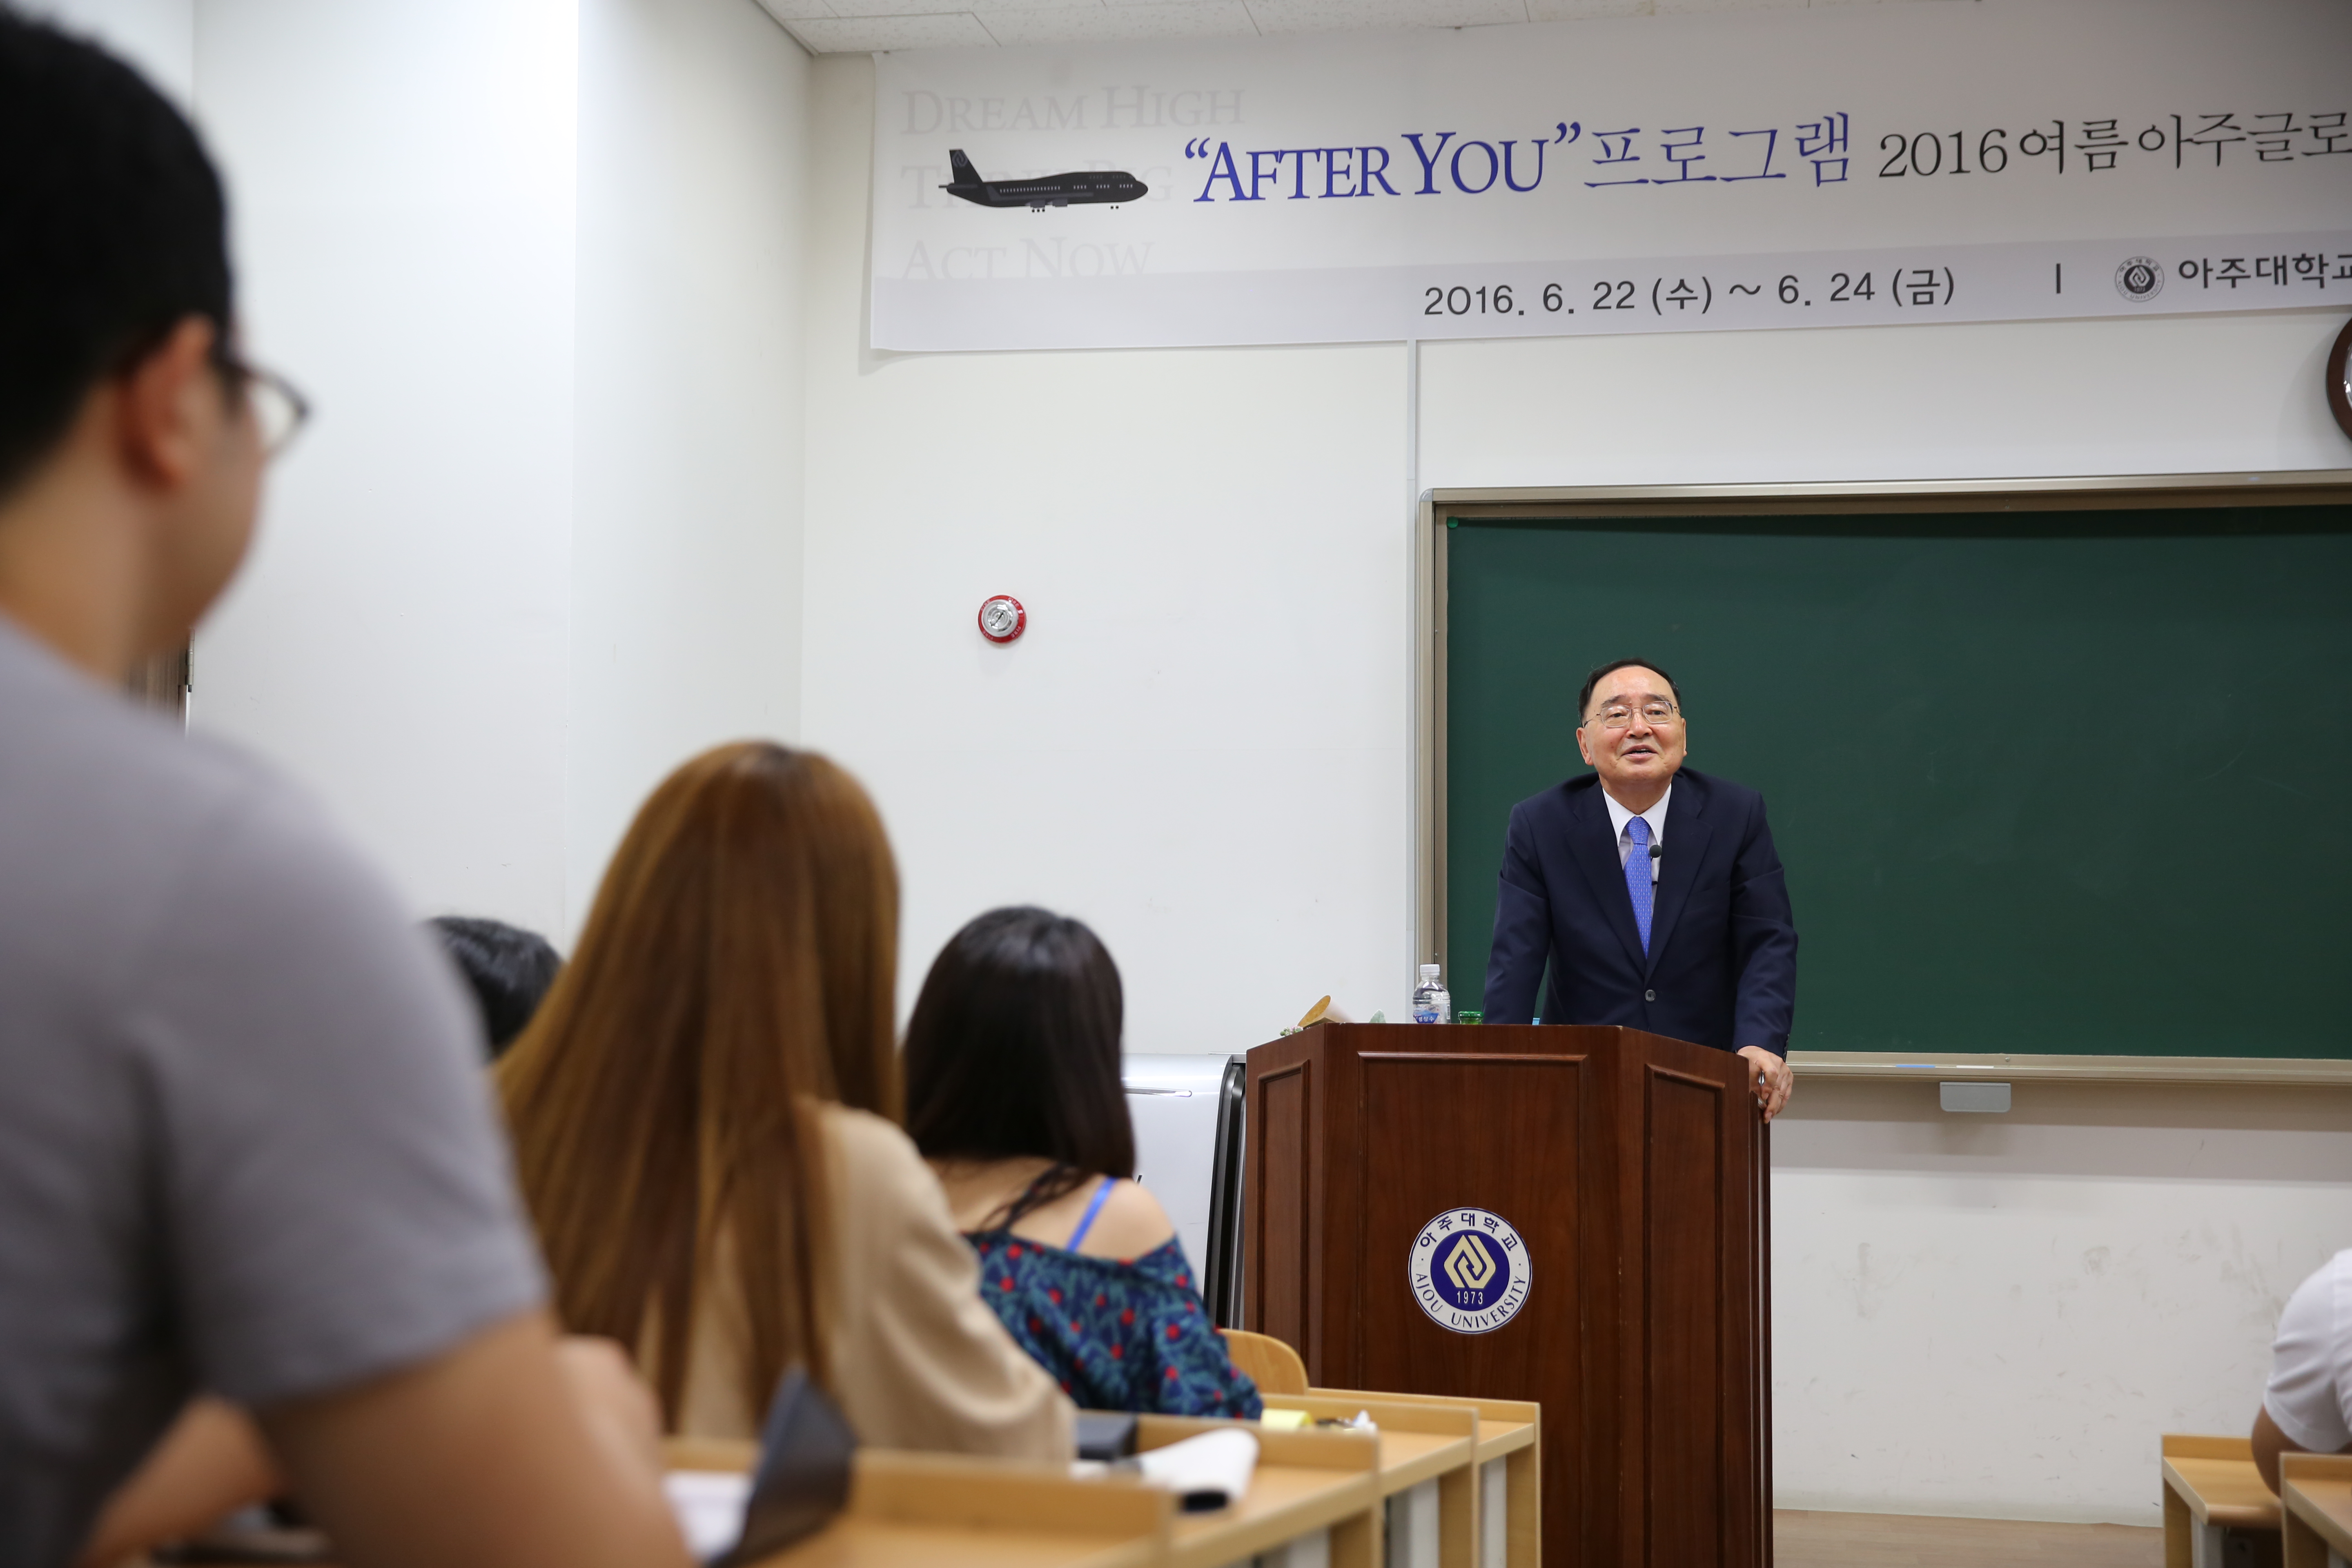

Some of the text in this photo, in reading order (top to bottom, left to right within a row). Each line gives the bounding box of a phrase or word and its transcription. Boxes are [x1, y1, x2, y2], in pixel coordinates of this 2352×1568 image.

[900, 84, 1246, 135] DREAM HIGH
[901, 236, 1156, 280] ACT NOW
[1424, 285, 1524, 316] 2016.
[1543, 283, 1574, 314] 6.
[1592, 281, 1635, 310] 22
[1778, 274, 1811, 306] 6.
[1830, 272, 1875, 302] 24
[1892, 267, 1954, 307] (금)
[1008, 597, 1020, 607] FIRE
[1011, 626, 1021, 638] FIRE
[1420, 1213, 1518, 1252] 아주대학교
[1416, 1273, 1526, 1328] AJOU UNIVERSITY
[1457, 1290, 1483, 1305] 1973
